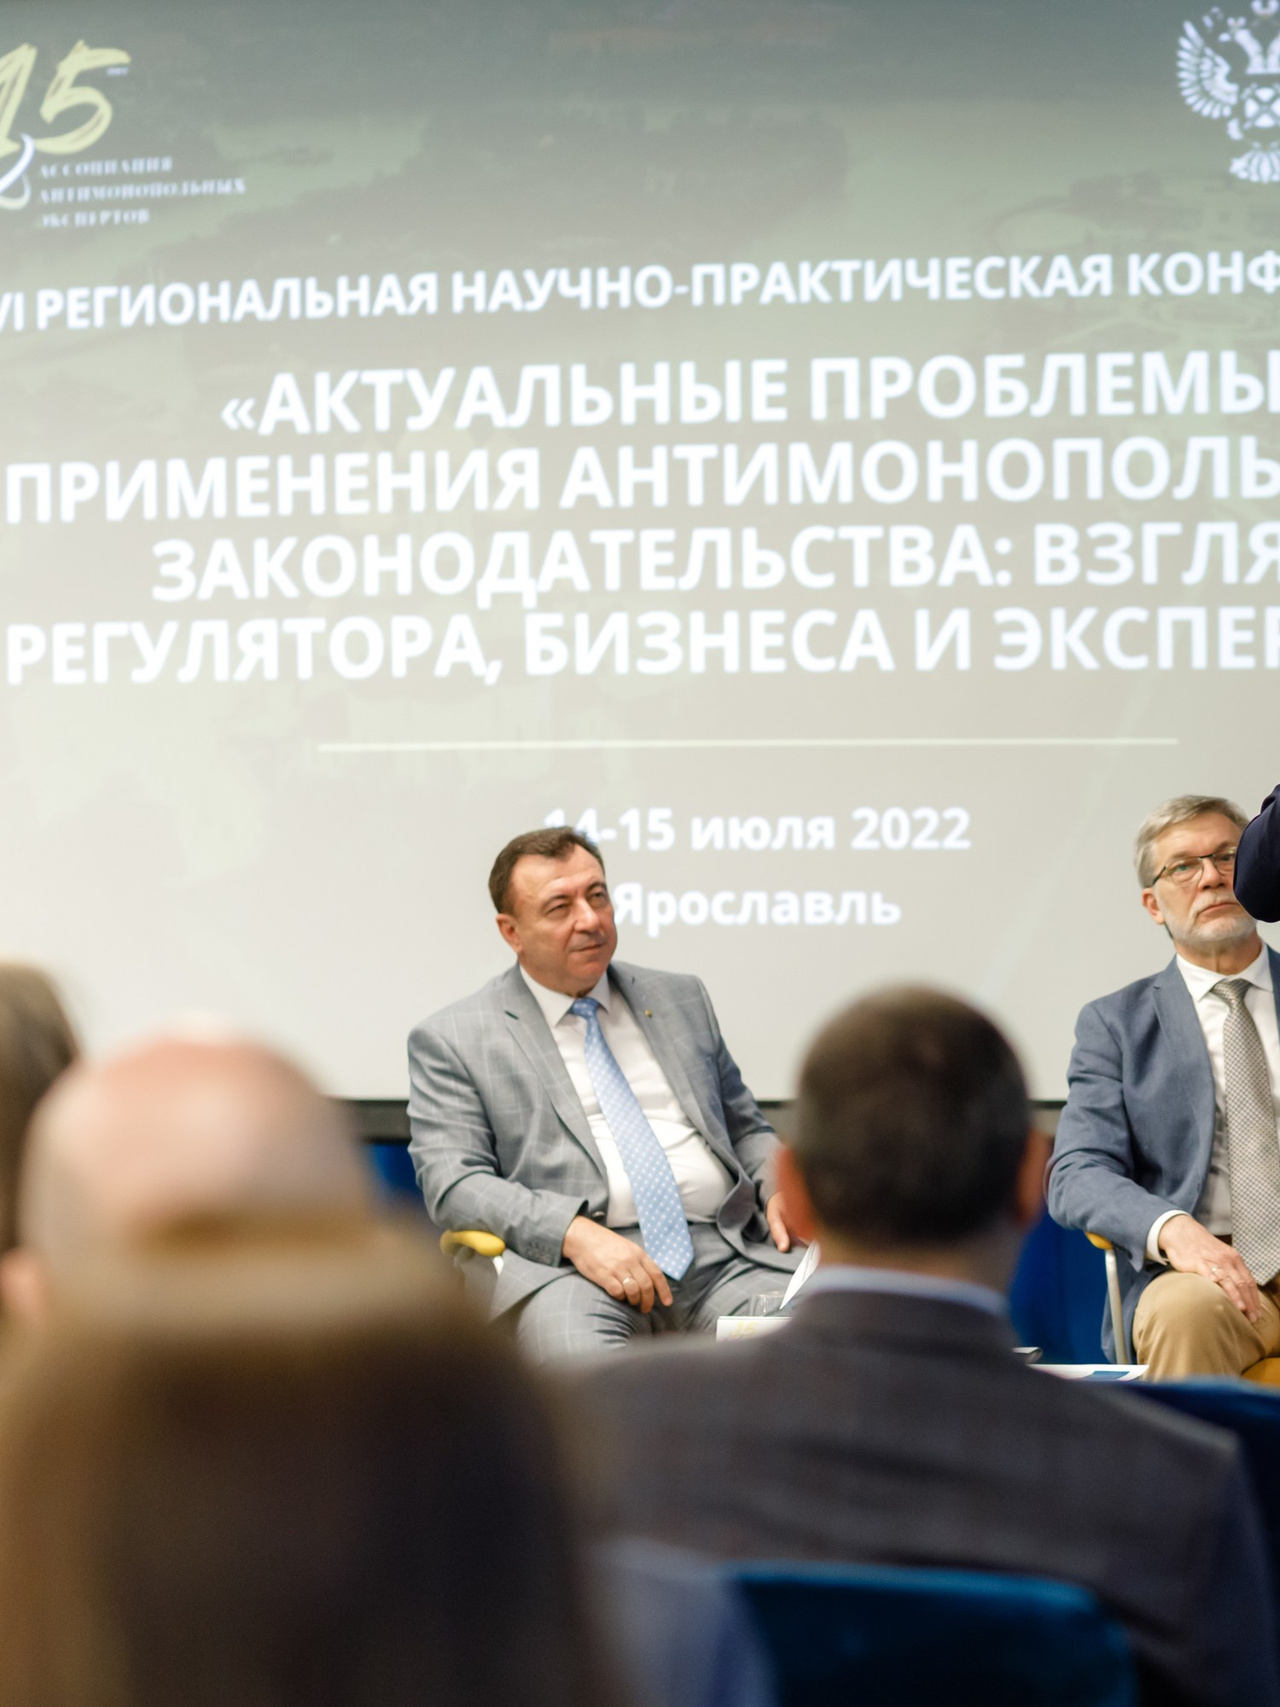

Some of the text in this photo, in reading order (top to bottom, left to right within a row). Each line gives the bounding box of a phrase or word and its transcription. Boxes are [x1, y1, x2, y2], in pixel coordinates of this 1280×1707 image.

[36, 272, 439, 331] РЕГИОНАЛЬНАЯ
[452, 253, 1112, 313] НАУЧНО-ПРАКТИЧЕСКАЯ
[220, 358, 789, 436] «АКТУАЛЬНЫЕ
[5, 447, 541, 525] ПРИМЕНЕНИЯ
[151, 523, 1011, 610] ЗАКОНОДАТЕЛЬСТВА:
[6, 612, 503, 687] РЕГУЛЯТОРА,
[524, 606, 896, 677] БИЗНЕСА
[914, 607, 972, 672] И
[690, 814, 836, 852] июля
[849, 806, 972, 851] 2022
[612, 881, 902, 939] Ярославль
